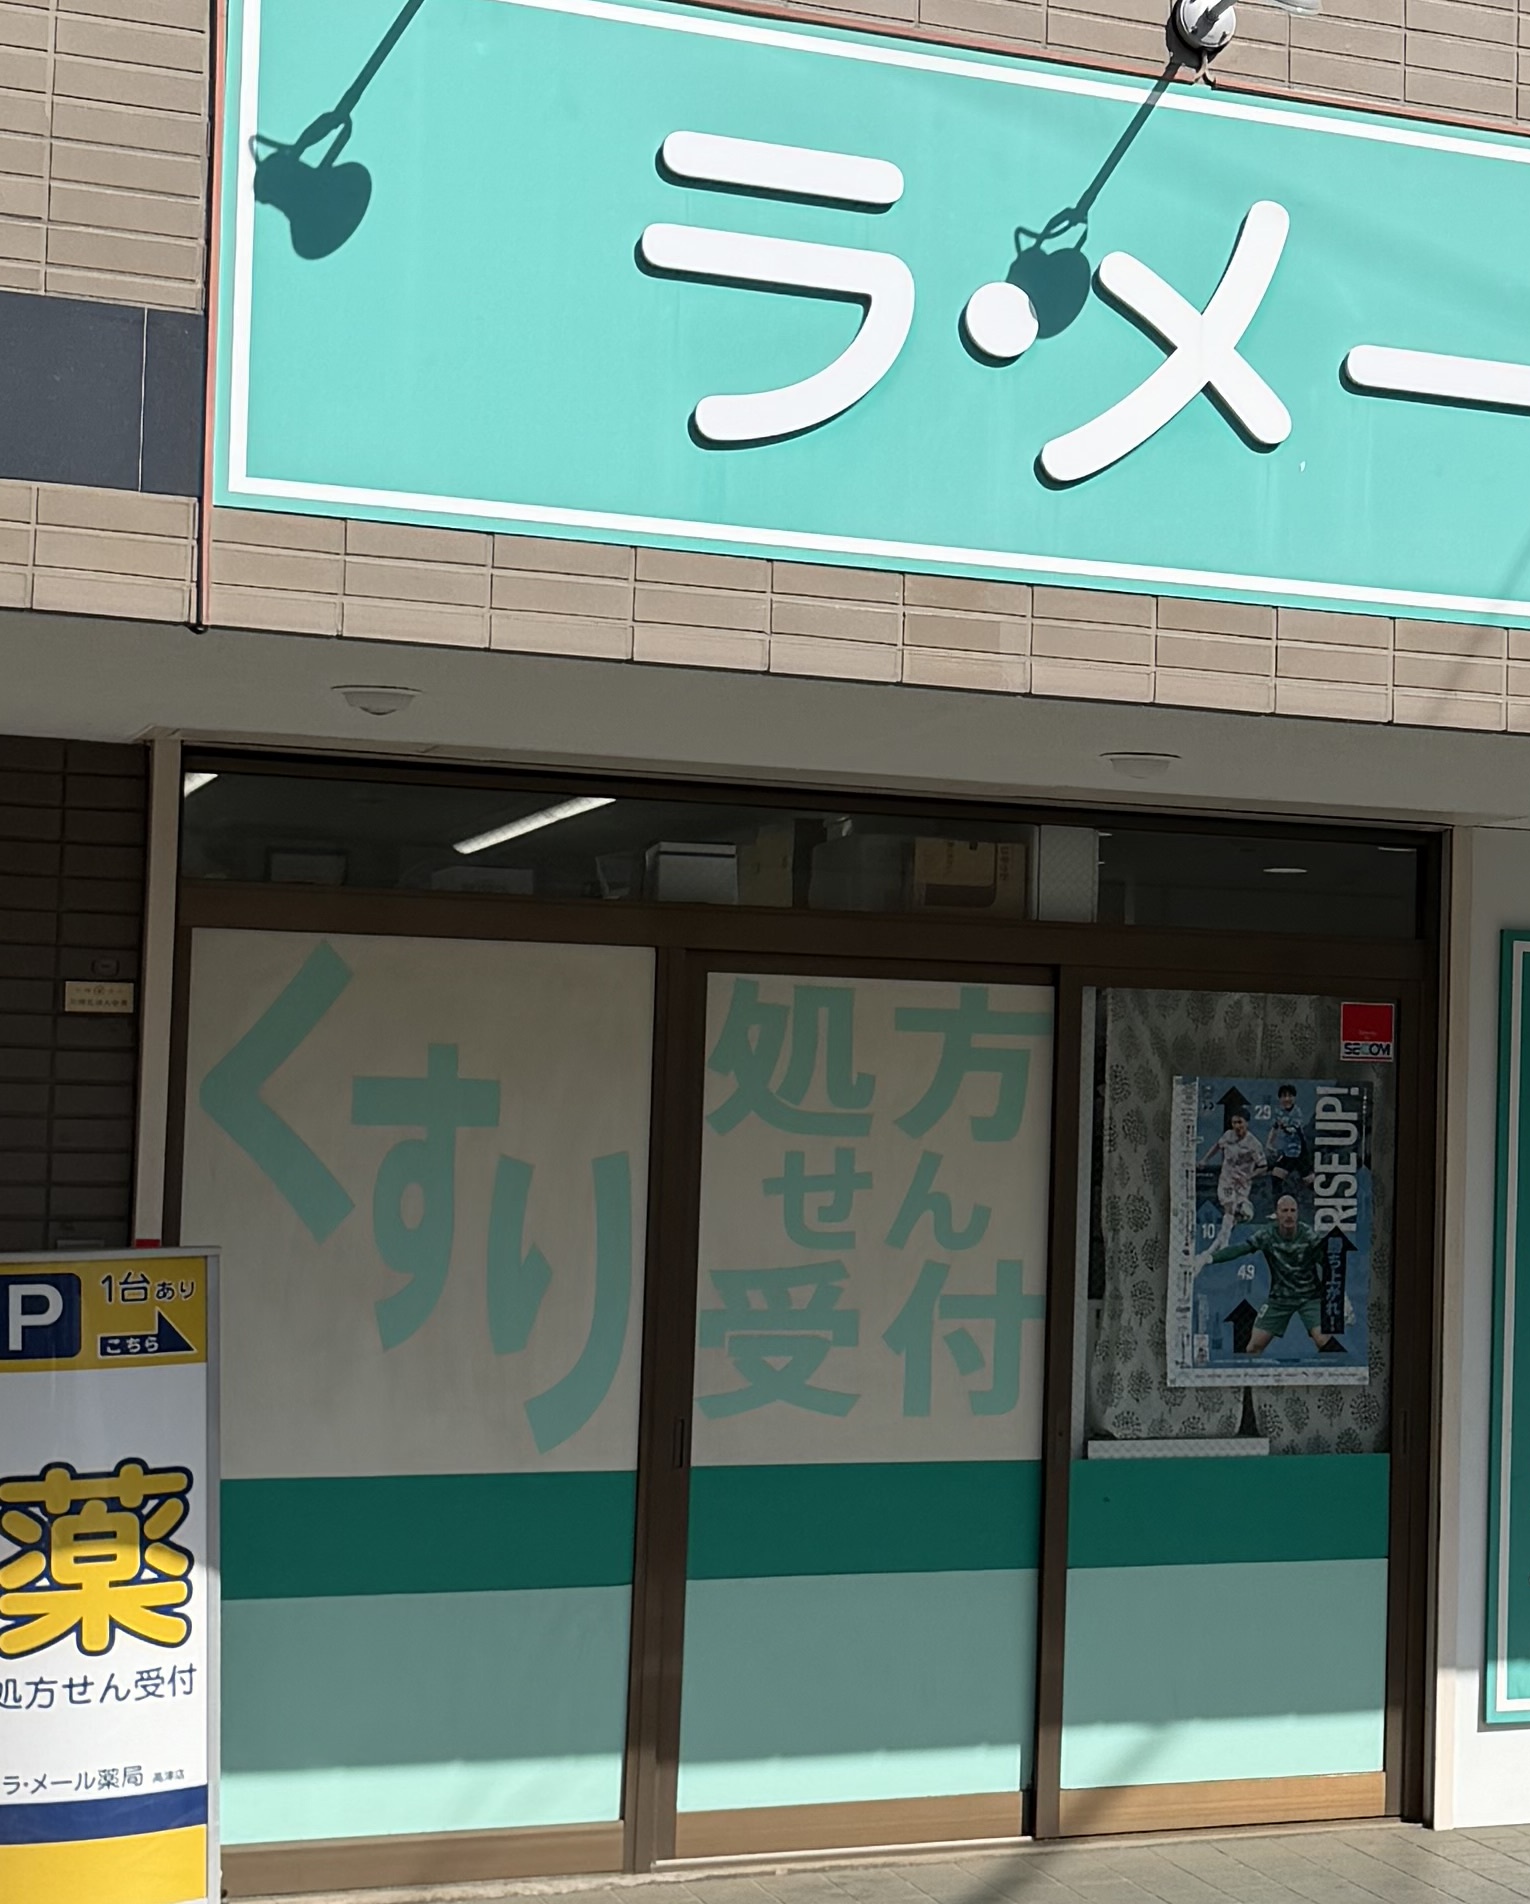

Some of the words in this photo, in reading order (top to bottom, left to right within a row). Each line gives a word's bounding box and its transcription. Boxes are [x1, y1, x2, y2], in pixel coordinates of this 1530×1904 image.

[704, 978, 1054, 1142] 処方
[1254, 1105, 1272, 1120] 29
[1314, 1086, 1360, 1146] UP!
[199, 939, 632, 1456] くすり
[762, 1147, 993, 1252] せん
[1313, 1151, 1358, 1232] RISE
[1202, 1225, 1214, 1239] 10
[101, 1272, 195, 1303] 1台あり
[1237, 1264, 1255, 1280] 49
[9, 1284, 63, 1351] P
[106, 1336, 159, 1354] こちら
[694, 1259, 1046, 1420] 受付
[0, 1457, 194, 1659] 薬
[3, 1765, 143, 1796] ラ・メール薬局
